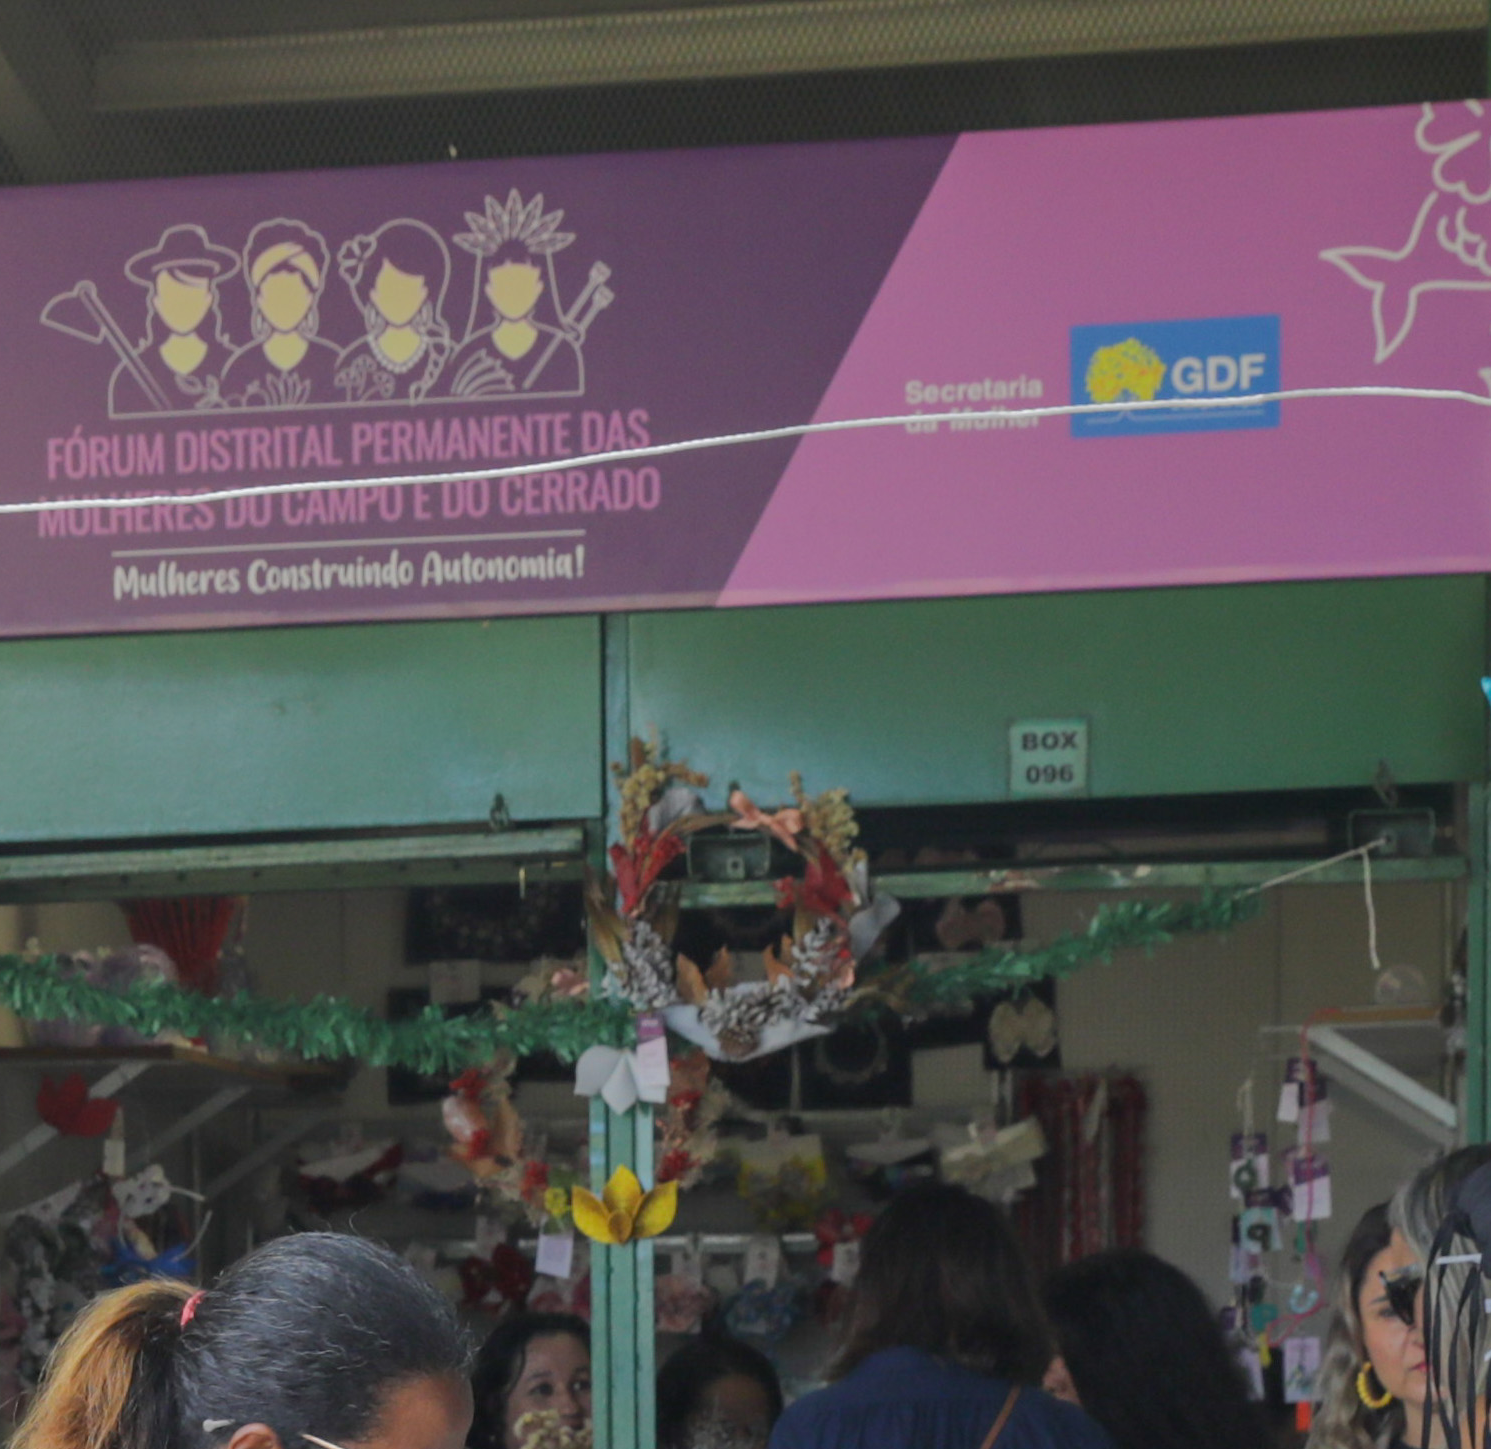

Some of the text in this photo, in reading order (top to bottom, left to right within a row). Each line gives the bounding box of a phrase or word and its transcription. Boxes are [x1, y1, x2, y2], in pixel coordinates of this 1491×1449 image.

[904, 373, 1044, 405] Secretaria
[1171, 352, 1267, 394] GDF
[46, 408, 651, 481] FÓRUM DISTRITAL PERMANENTE DAS
[37, 465, 663, 539] MULHERES DO CAMPO E DO CERRADO
[112, 543, 587, 602] Mulheres Construindo Autonomia!
[1020, 730, 1079, 753] BOX
